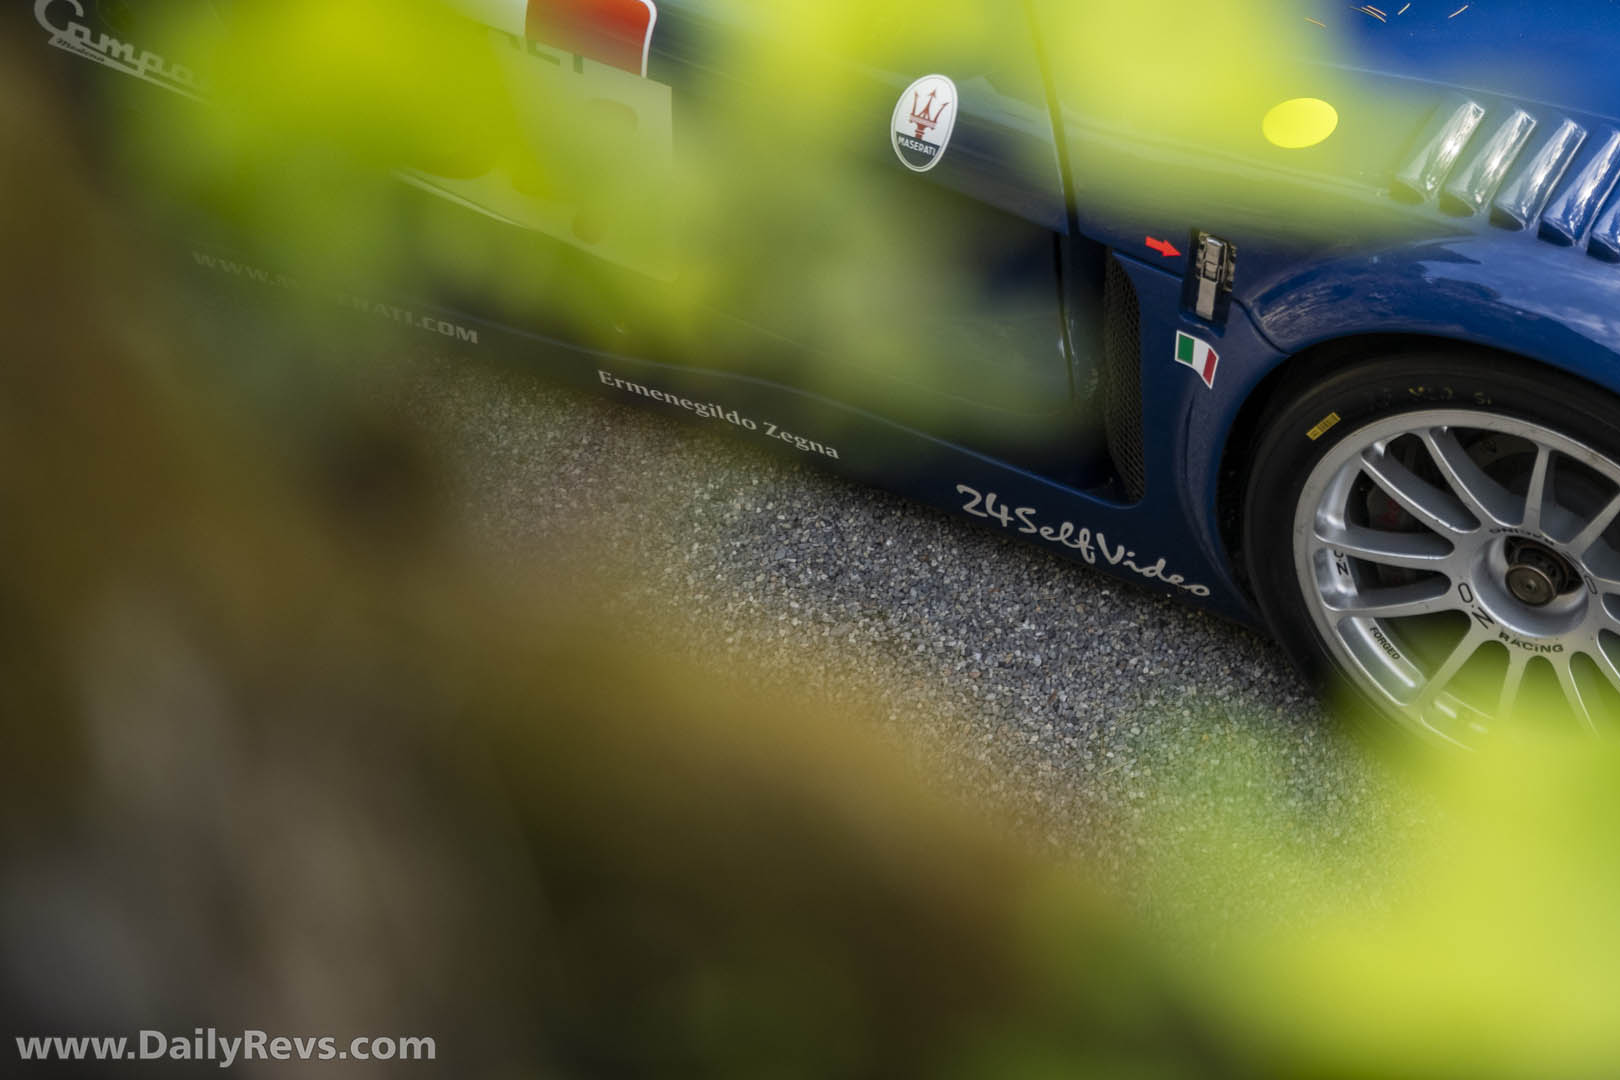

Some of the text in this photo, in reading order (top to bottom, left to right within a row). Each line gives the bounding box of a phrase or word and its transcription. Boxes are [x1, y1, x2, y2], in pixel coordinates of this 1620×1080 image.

[897, 136, 937, 156] MASERATI
[598, 370, 840, 459] Ermenegildo Zegna
[1370, 626, 1401, 660] FORGED
